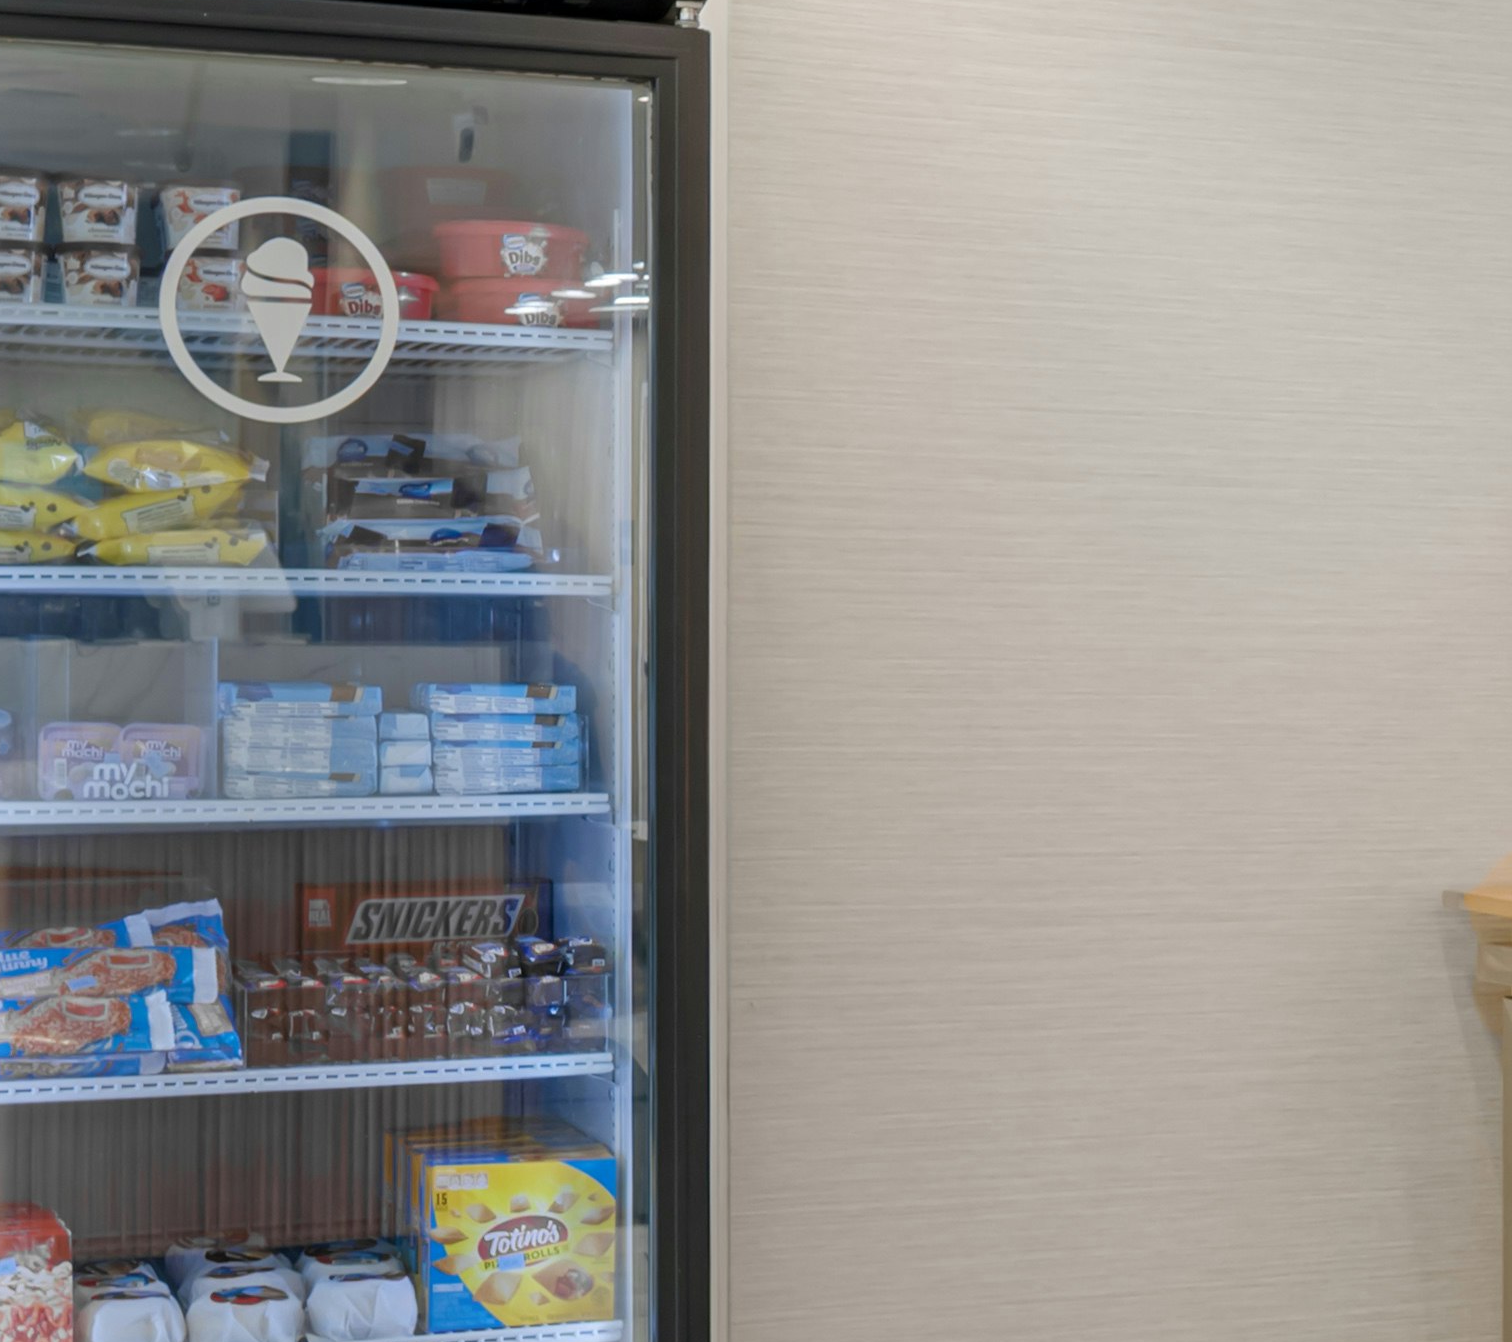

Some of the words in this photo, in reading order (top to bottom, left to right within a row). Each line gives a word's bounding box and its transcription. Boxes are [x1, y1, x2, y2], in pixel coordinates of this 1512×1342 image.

[508, 251, 540, 265] Dibs
[93, 763, 138, 783] my
[83, 777, 169, 800] mochi
[350, 897, 520, 942] SNICKERS
[484, 1220, 560, 1256] Totino's
